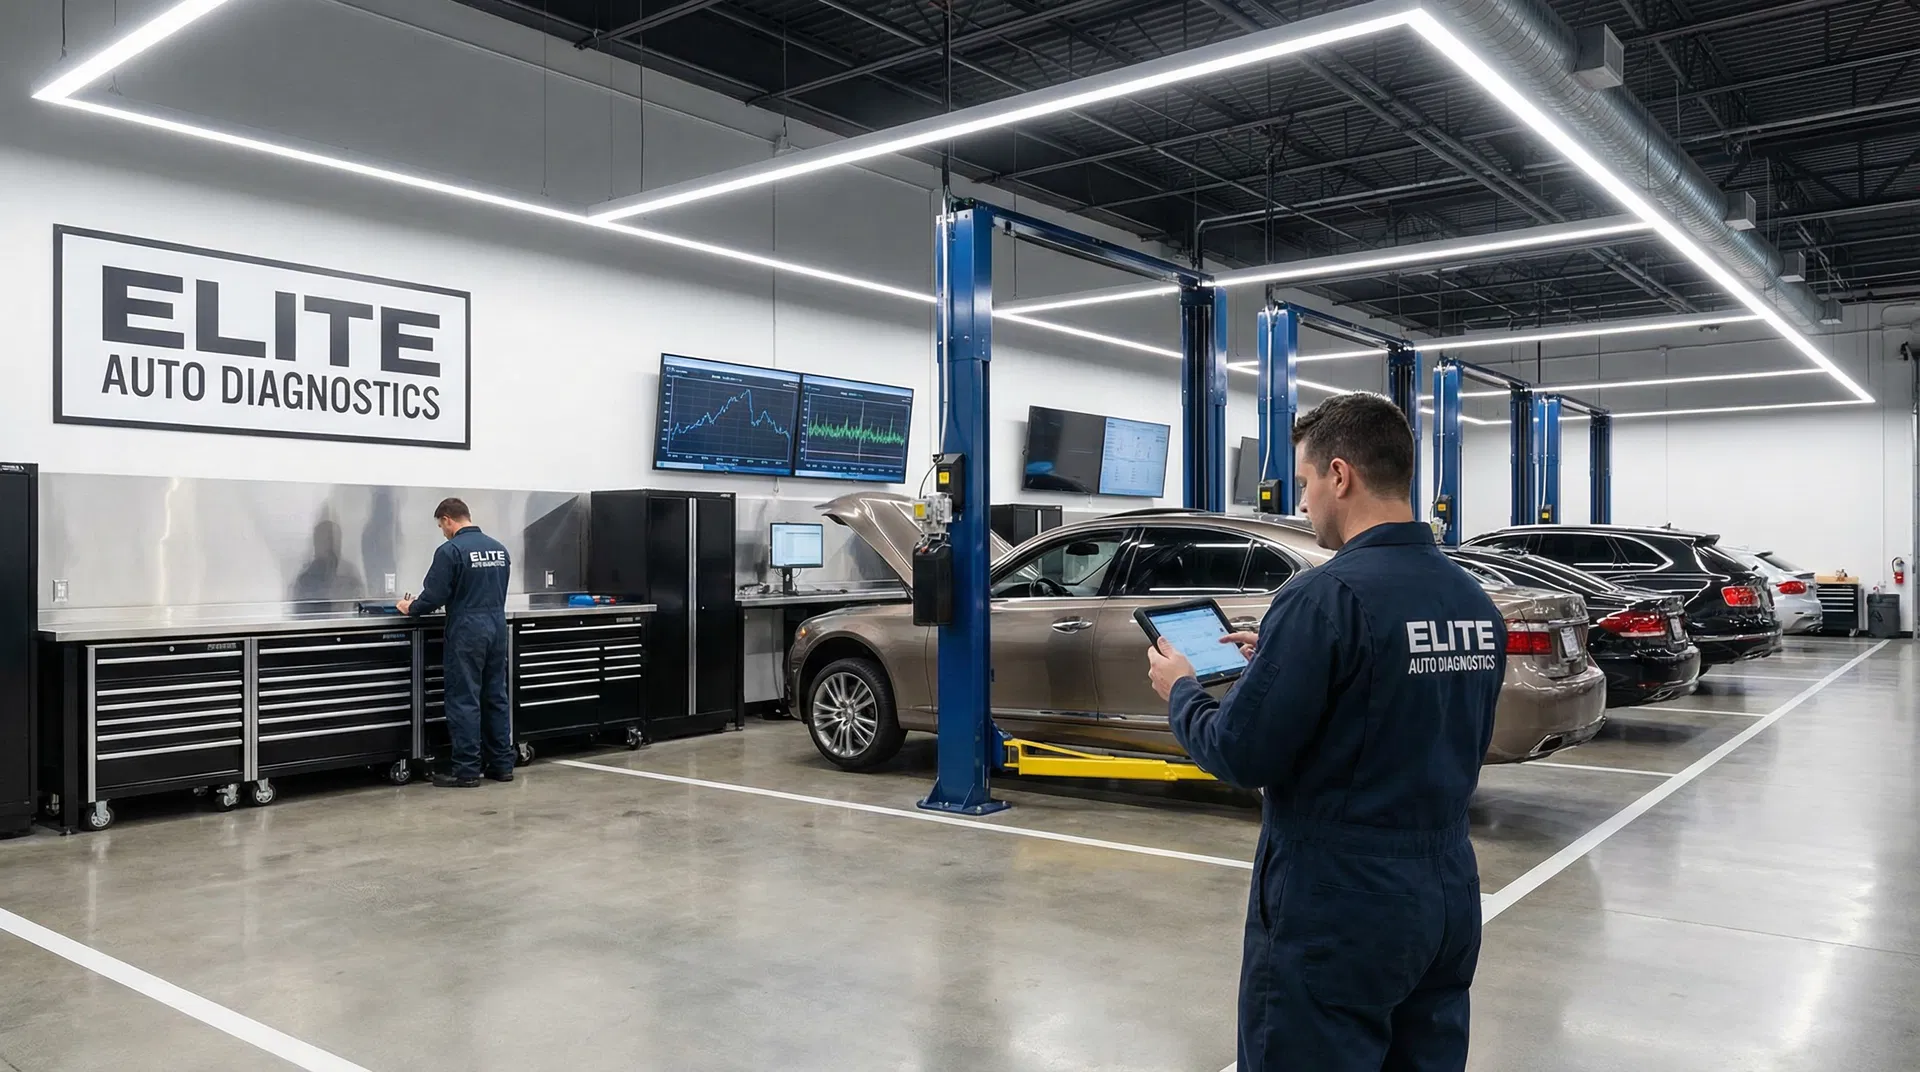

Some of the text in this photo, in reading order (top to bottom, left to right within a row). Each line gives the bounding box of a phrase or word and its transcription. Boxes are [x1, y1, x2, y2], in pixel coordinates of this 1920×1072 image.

[103, 265, 441, 378] ELITE
[101, 354, 440, 421] AUTO DIAGNOSTICS
[469, 550, 506, 562] ELITE
[1406, 620, 1496, 654] ELITE
[1408, 655, 1496, 675] AUTO DIAGNOSTICS
